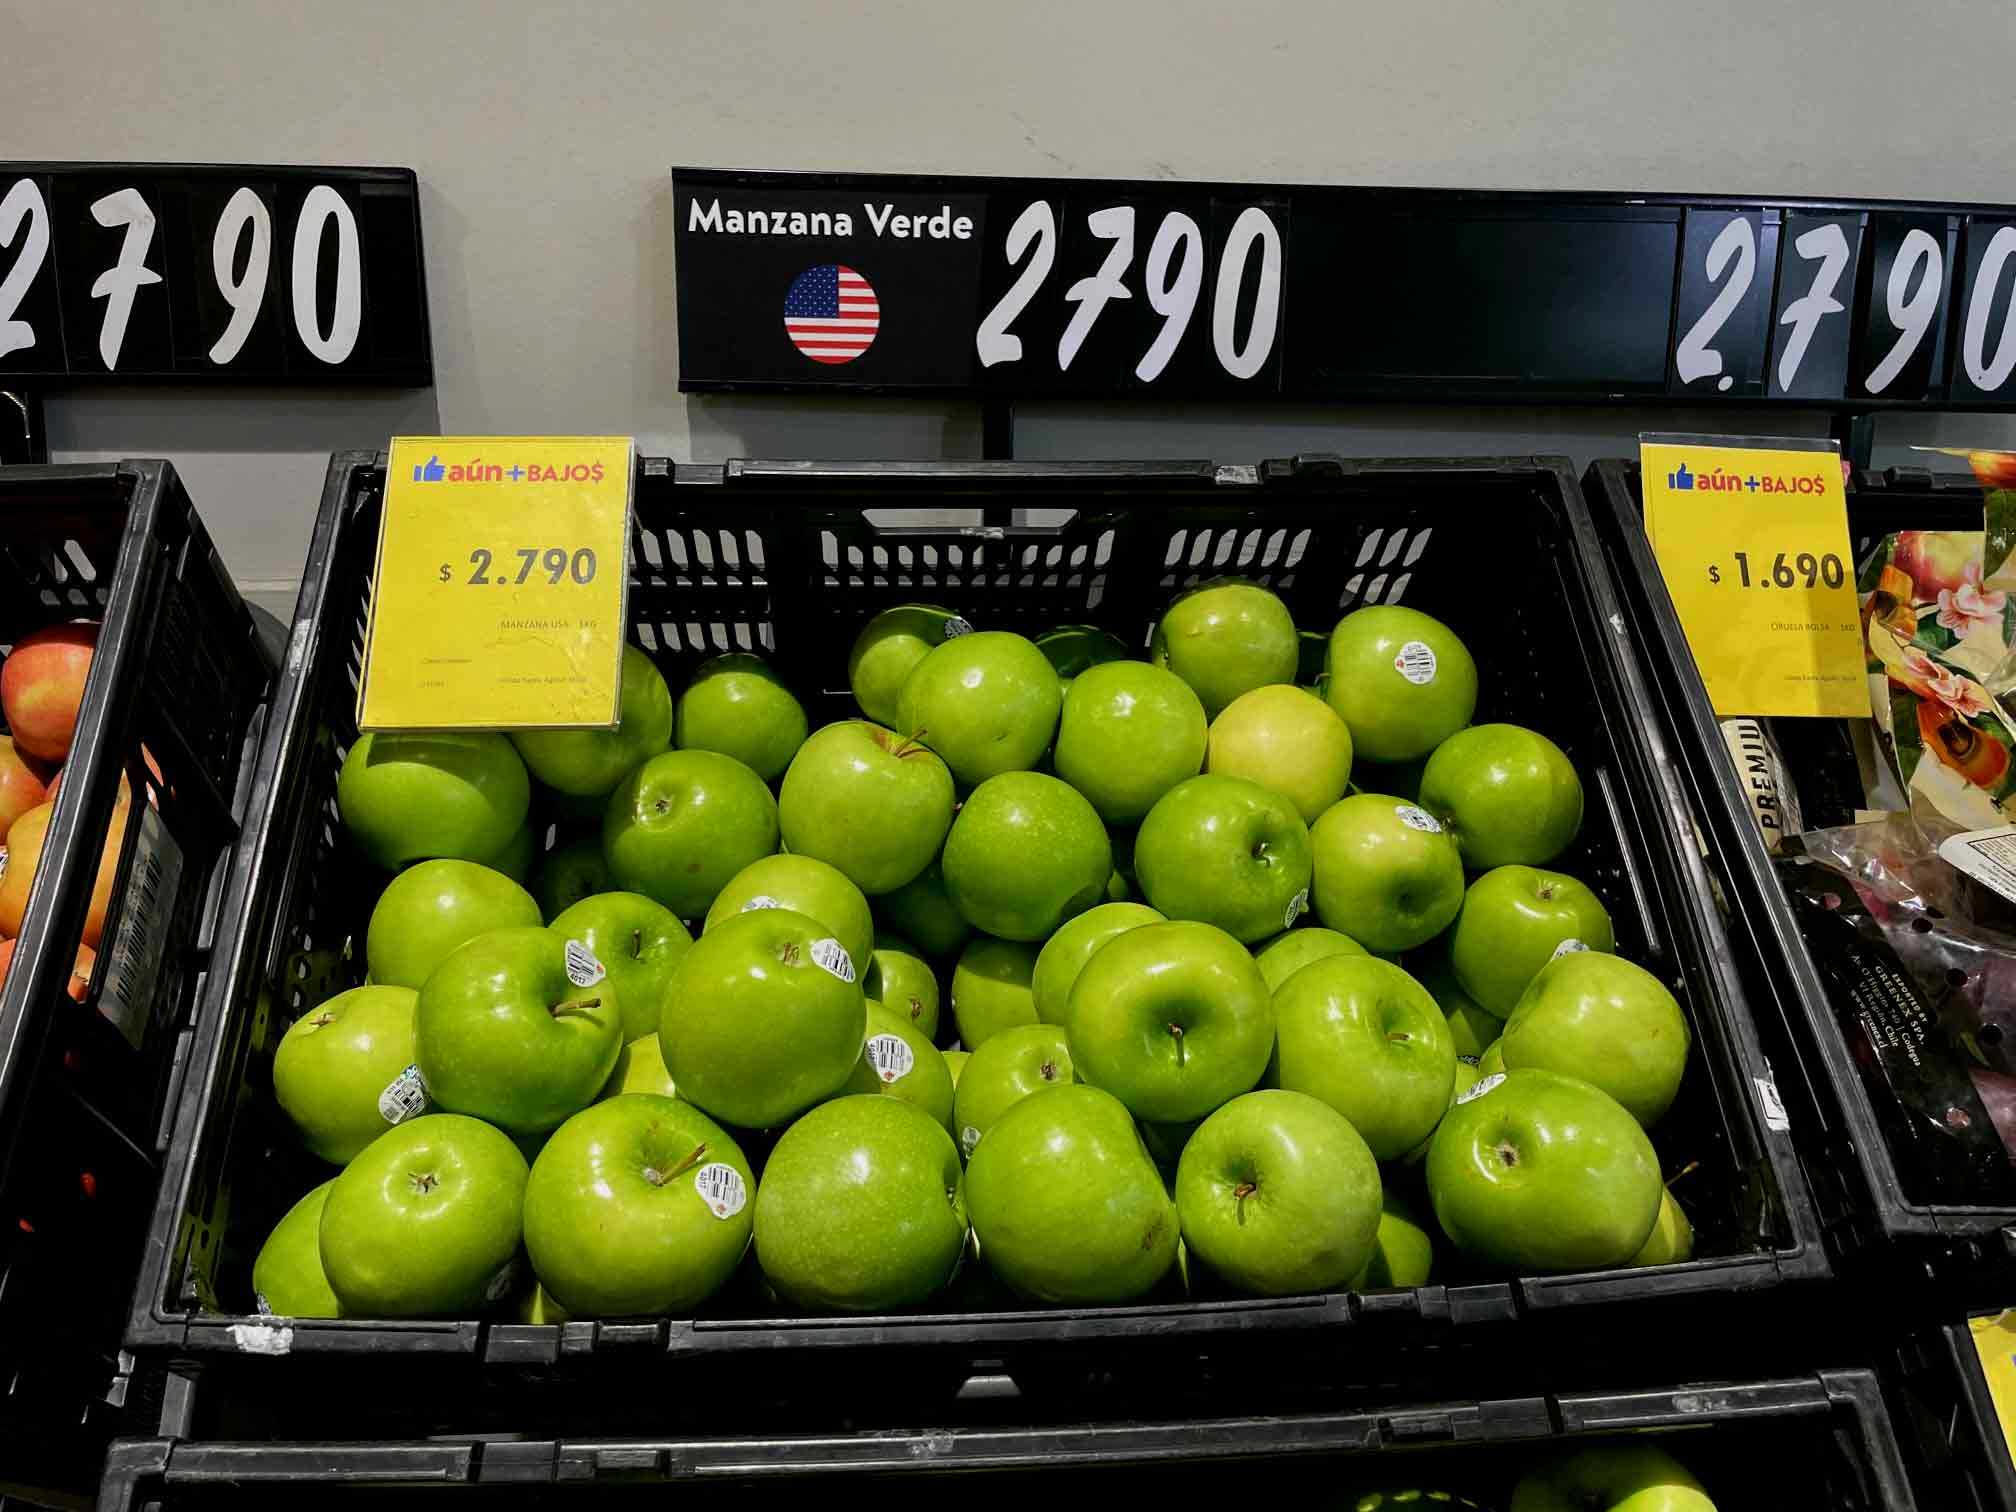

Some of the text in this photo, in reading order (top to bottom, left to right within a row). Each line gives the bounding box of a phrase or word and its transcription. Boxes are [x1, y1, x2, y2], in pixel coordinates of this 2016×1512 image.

[688, 197, 974, 240] Manzana Verde
[976, 200, 1282, 382] 2790
[467, 548, 597, 585] 2.790
[1734, 552, 1845, 590] 1.690
[1737, 718, 1780, 829] PREMIU
[1875, 965, 1913, 1018] GREENEX
[1885, 1025, 1899, 1048] Chile
